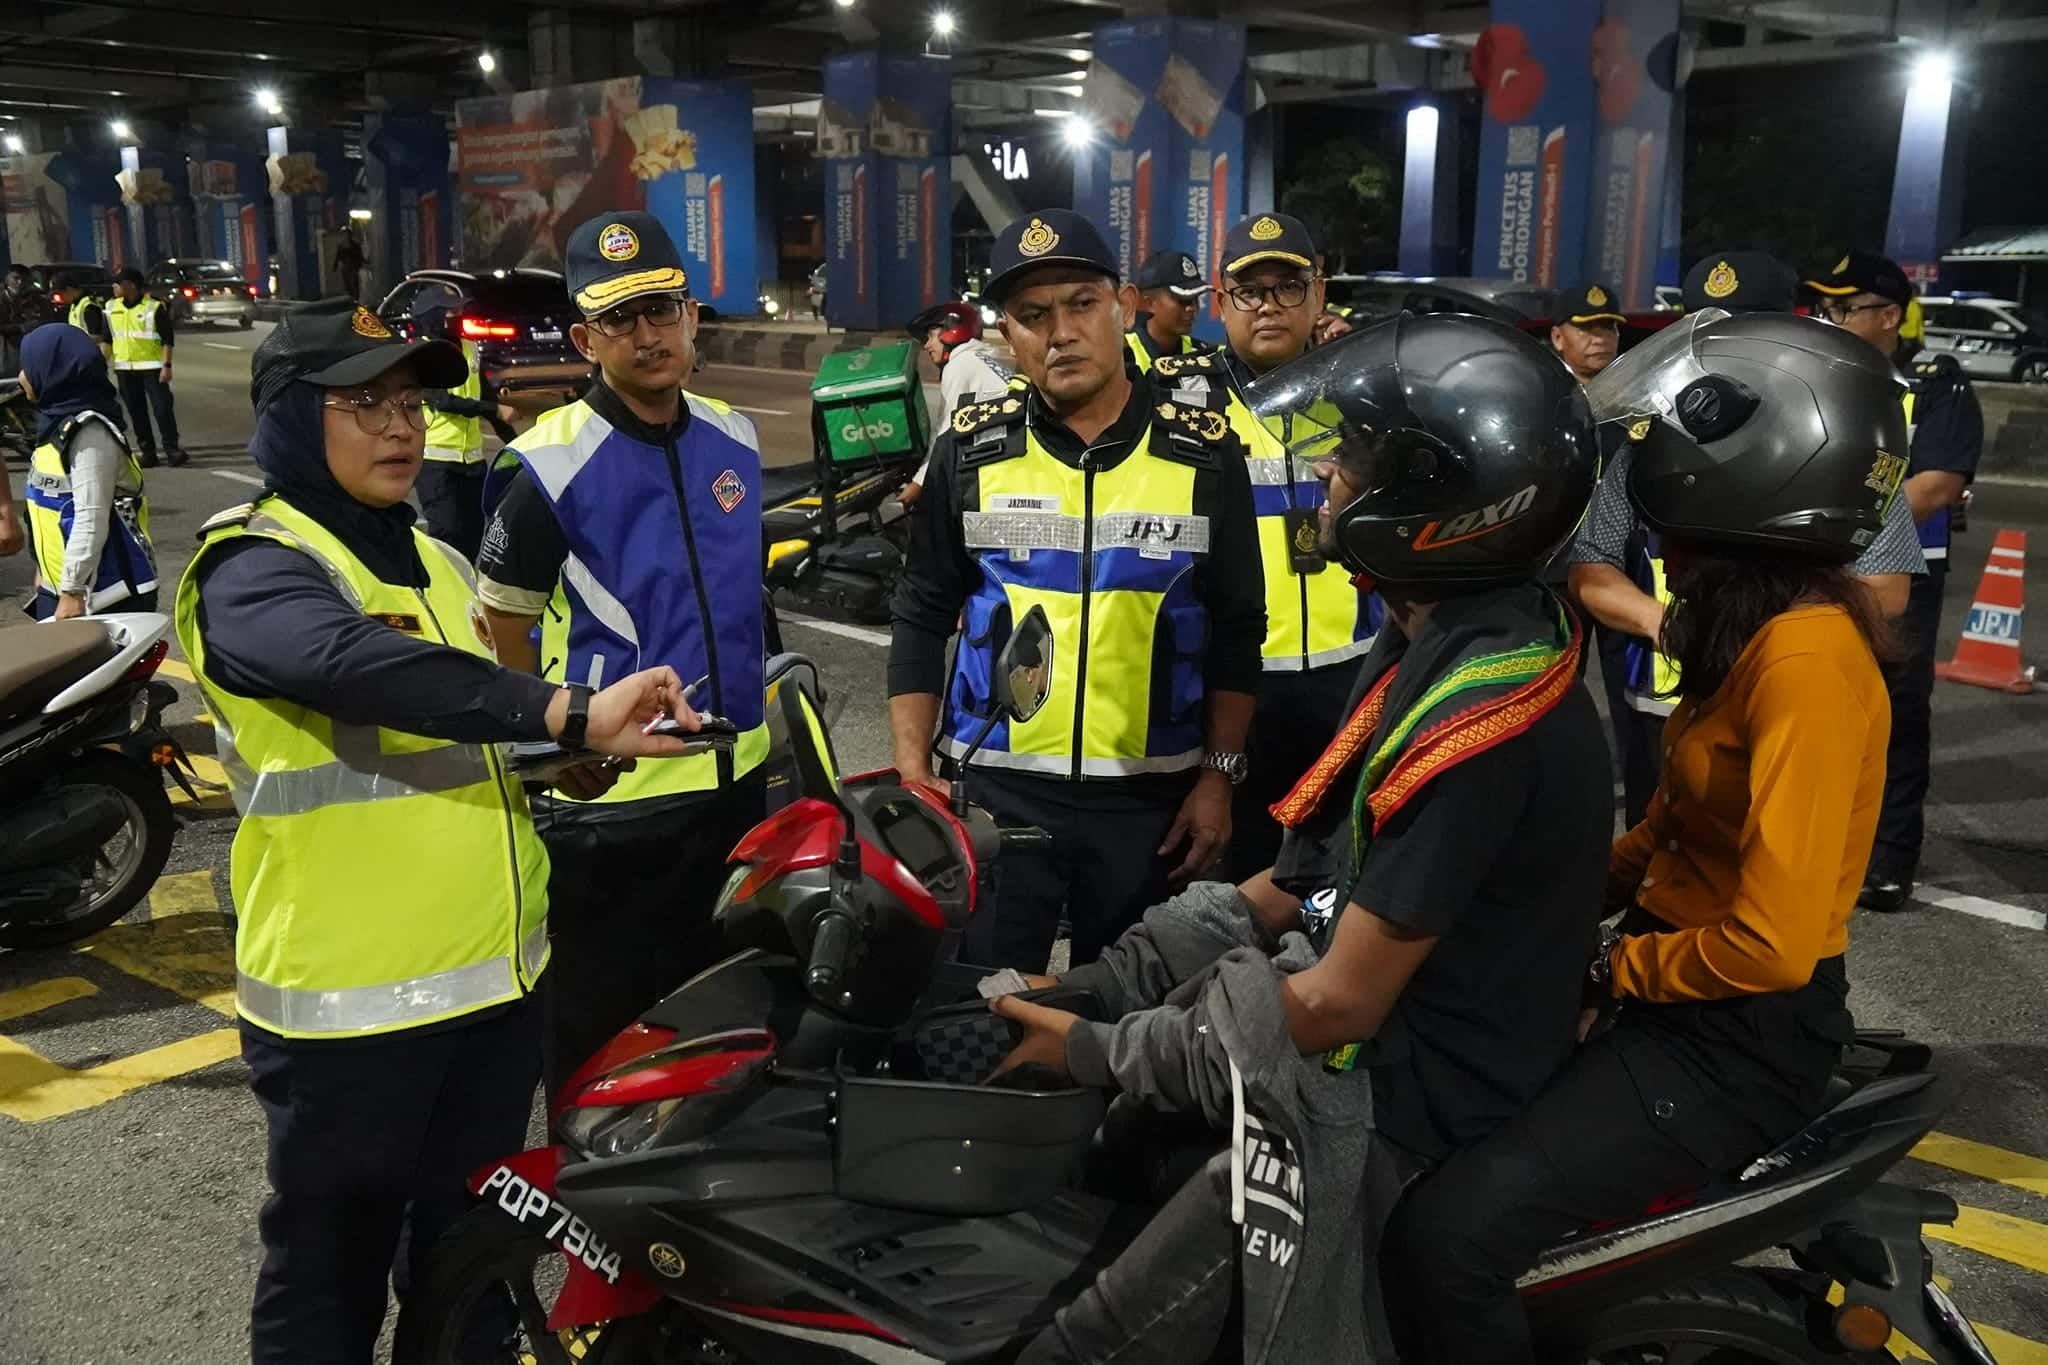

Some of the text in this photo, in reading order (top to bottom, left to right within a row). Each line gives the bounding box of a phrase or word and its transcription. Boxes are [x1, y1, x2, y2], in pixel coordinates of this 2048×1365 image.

[687, 200, 697, 252] PELUANG
[1109, 187, 1121, 227] LUAS
[1188, 187, 1200, 227] LUAS
[1498, 171, 1519, 269] PENCETUS
[1513, 171, 1534, 284] DORONGAN
[842, 420, 894, 442] Grab
[40, 477, 60, 489] JPJ
[1125, 520, 1182, 541] JPJ
[1971, 609, 2014, 638] JPJ
[478, 1166, 622, 1284] PQP7994
[1243, 1223, 1295, 1267] EW
